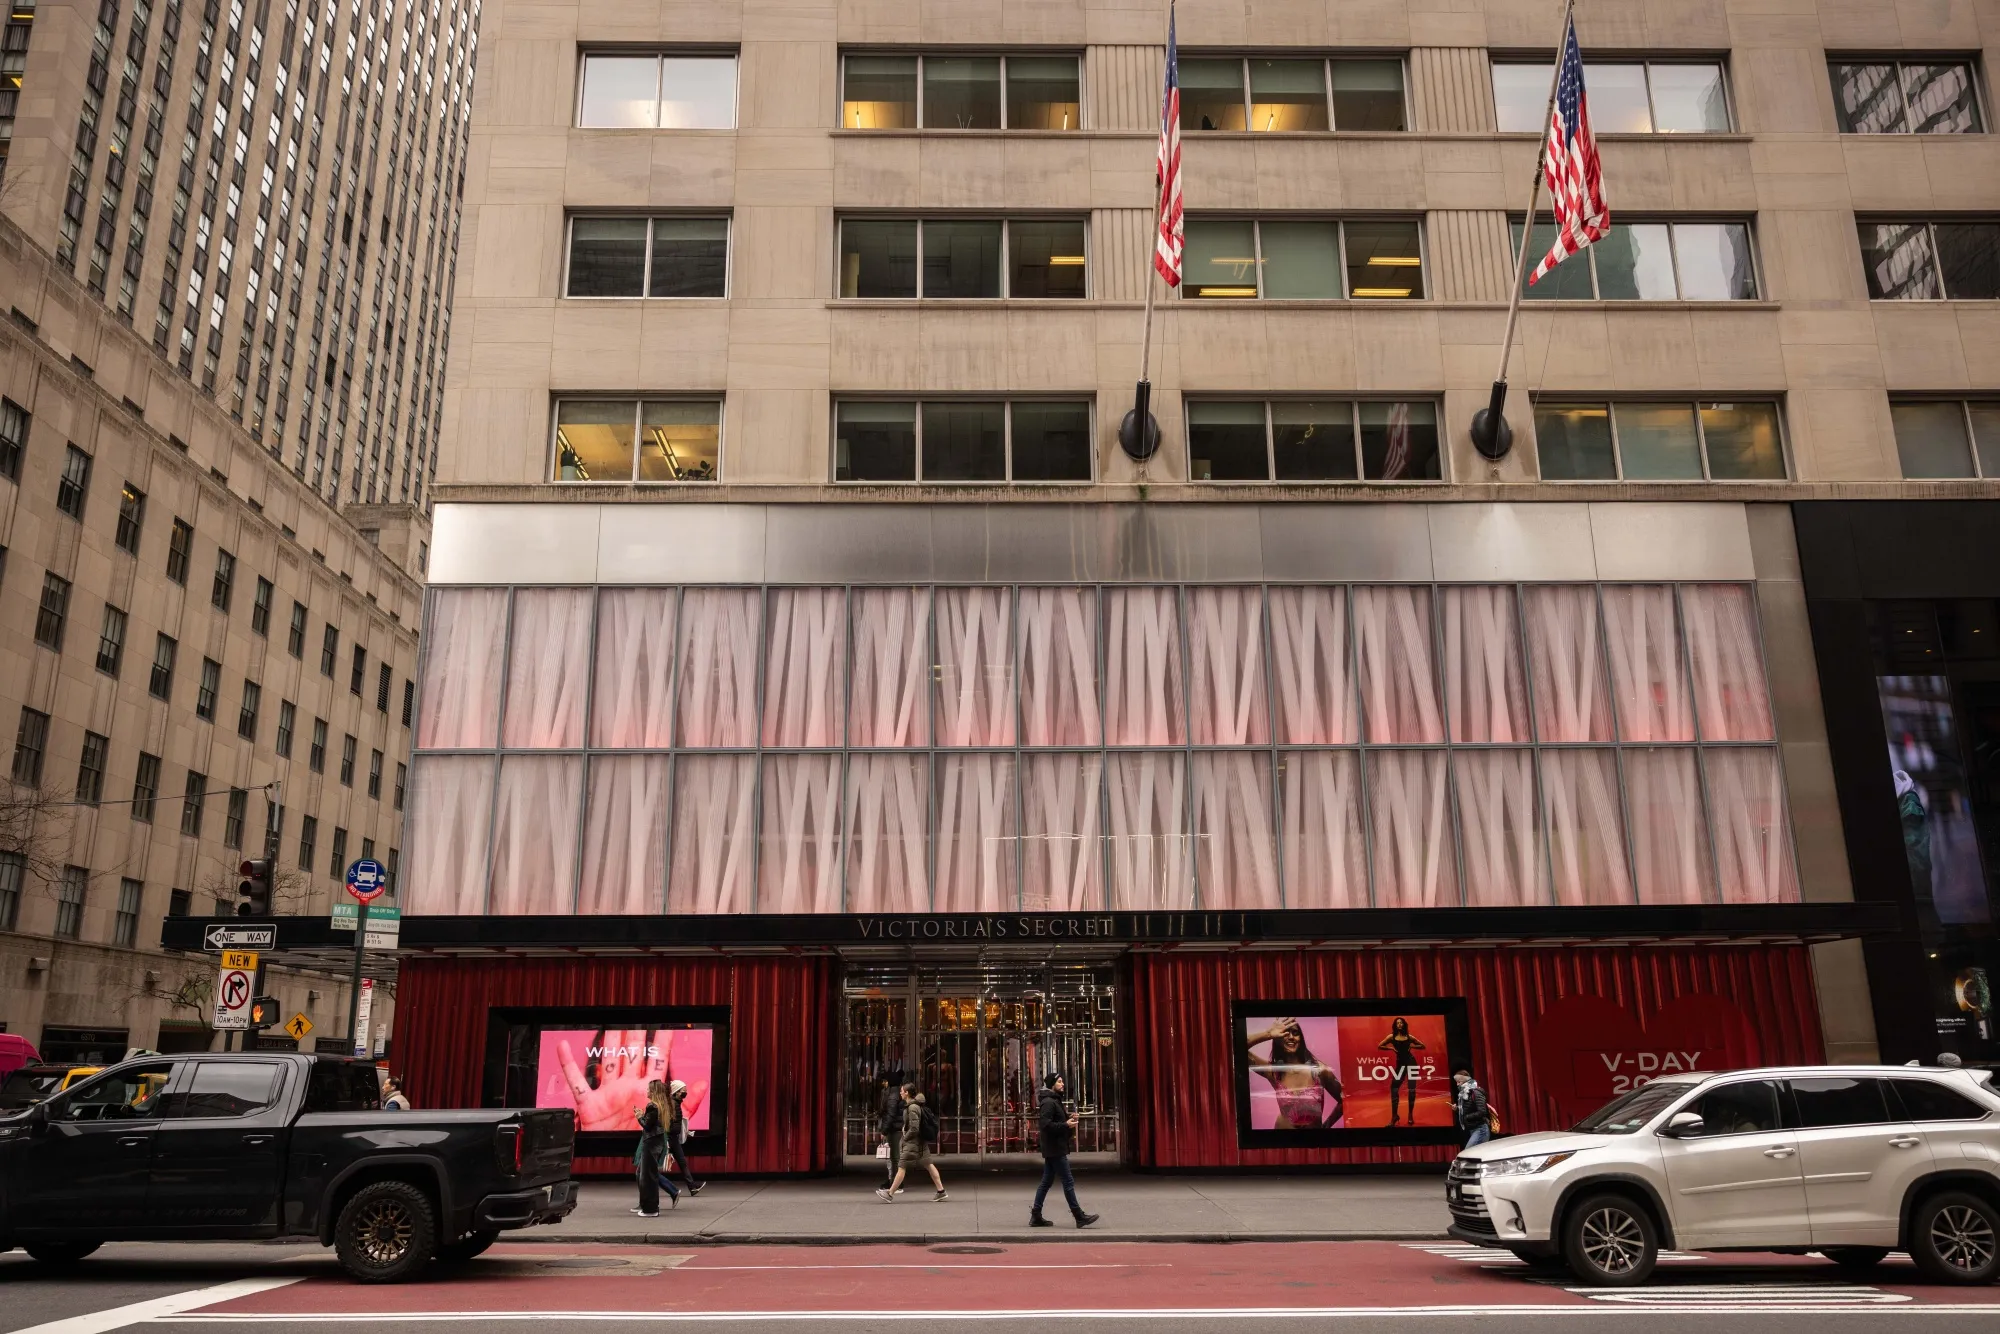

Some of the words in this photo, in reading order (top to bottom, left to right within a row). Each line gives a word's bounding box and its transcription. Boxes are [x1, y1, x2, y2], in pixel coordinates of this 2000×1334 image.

[349, 885, 357, 893] NO
[356, 887, 382, 897] STANDING
[858, 919, 1006, 938] VICTORIA'S
[1019, 917, 1112, 937] SECRET
[214, 932, 236, 942] ONE
[246, 932, 269, 942] WAY
[229, 954, 251, 967] NEW
[216, 1015, 248, 1024] 10AM-10PM
[586, 1046, 639, 1058] WHAT
[643, 1046, 660, 1058] IS
[1356, 1057, 1389, 1065] WHAT
[1423, 1056, 1434, 1064] IS
[1600, 1051, 1701, 1072] V-DAY
[1358, 1065, 1436, 1081] LOVE?
[1612, 1074, 1652, 1095] 20
